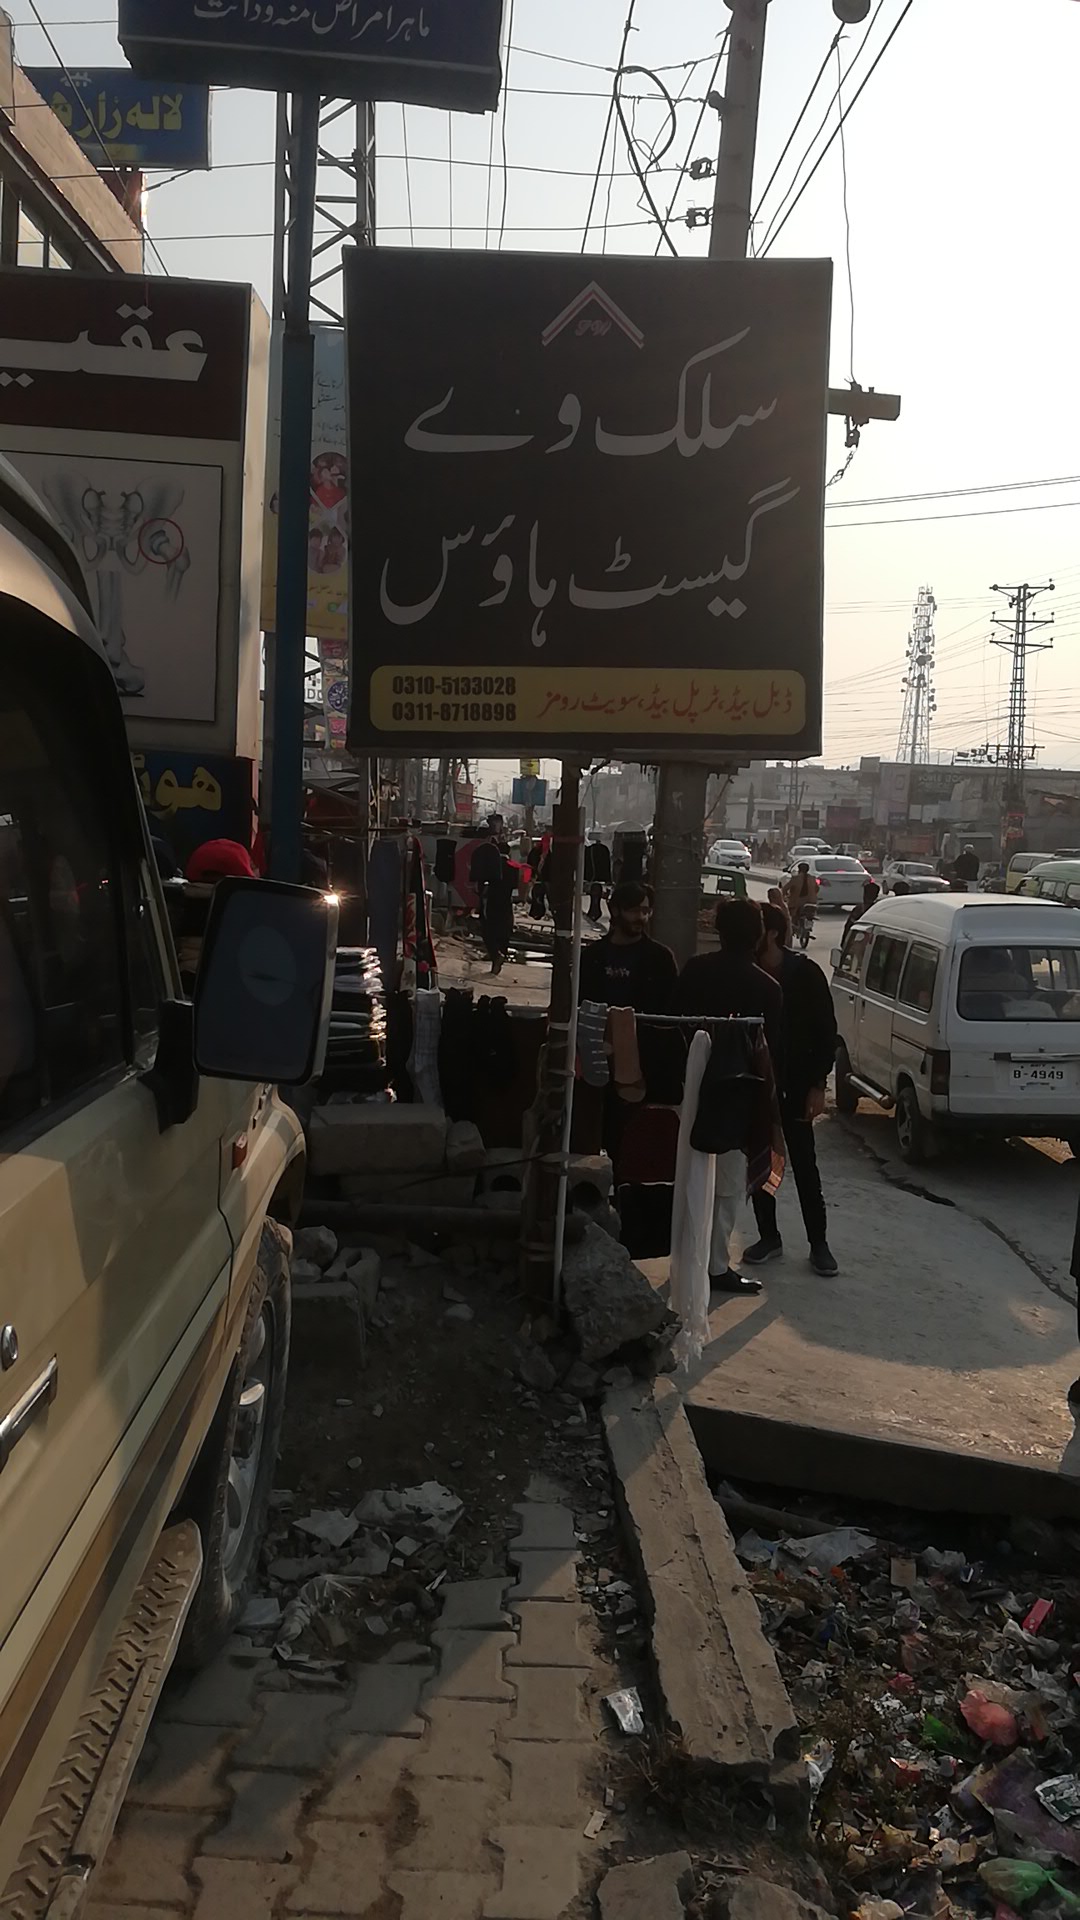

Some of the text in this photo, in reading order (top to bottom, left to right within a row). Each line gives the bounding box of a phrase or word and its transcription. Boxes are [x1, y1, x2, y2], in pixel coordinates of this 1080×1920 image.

[595, 326, 778, 458] سلک
[568, 477, 801, 620] گیسٹ
[391, 675, 517, 696] 0310-5133028
[391, 702, 517, 722] 0311-8718898
[1013, 1069, 1064, 1080] B-4949
